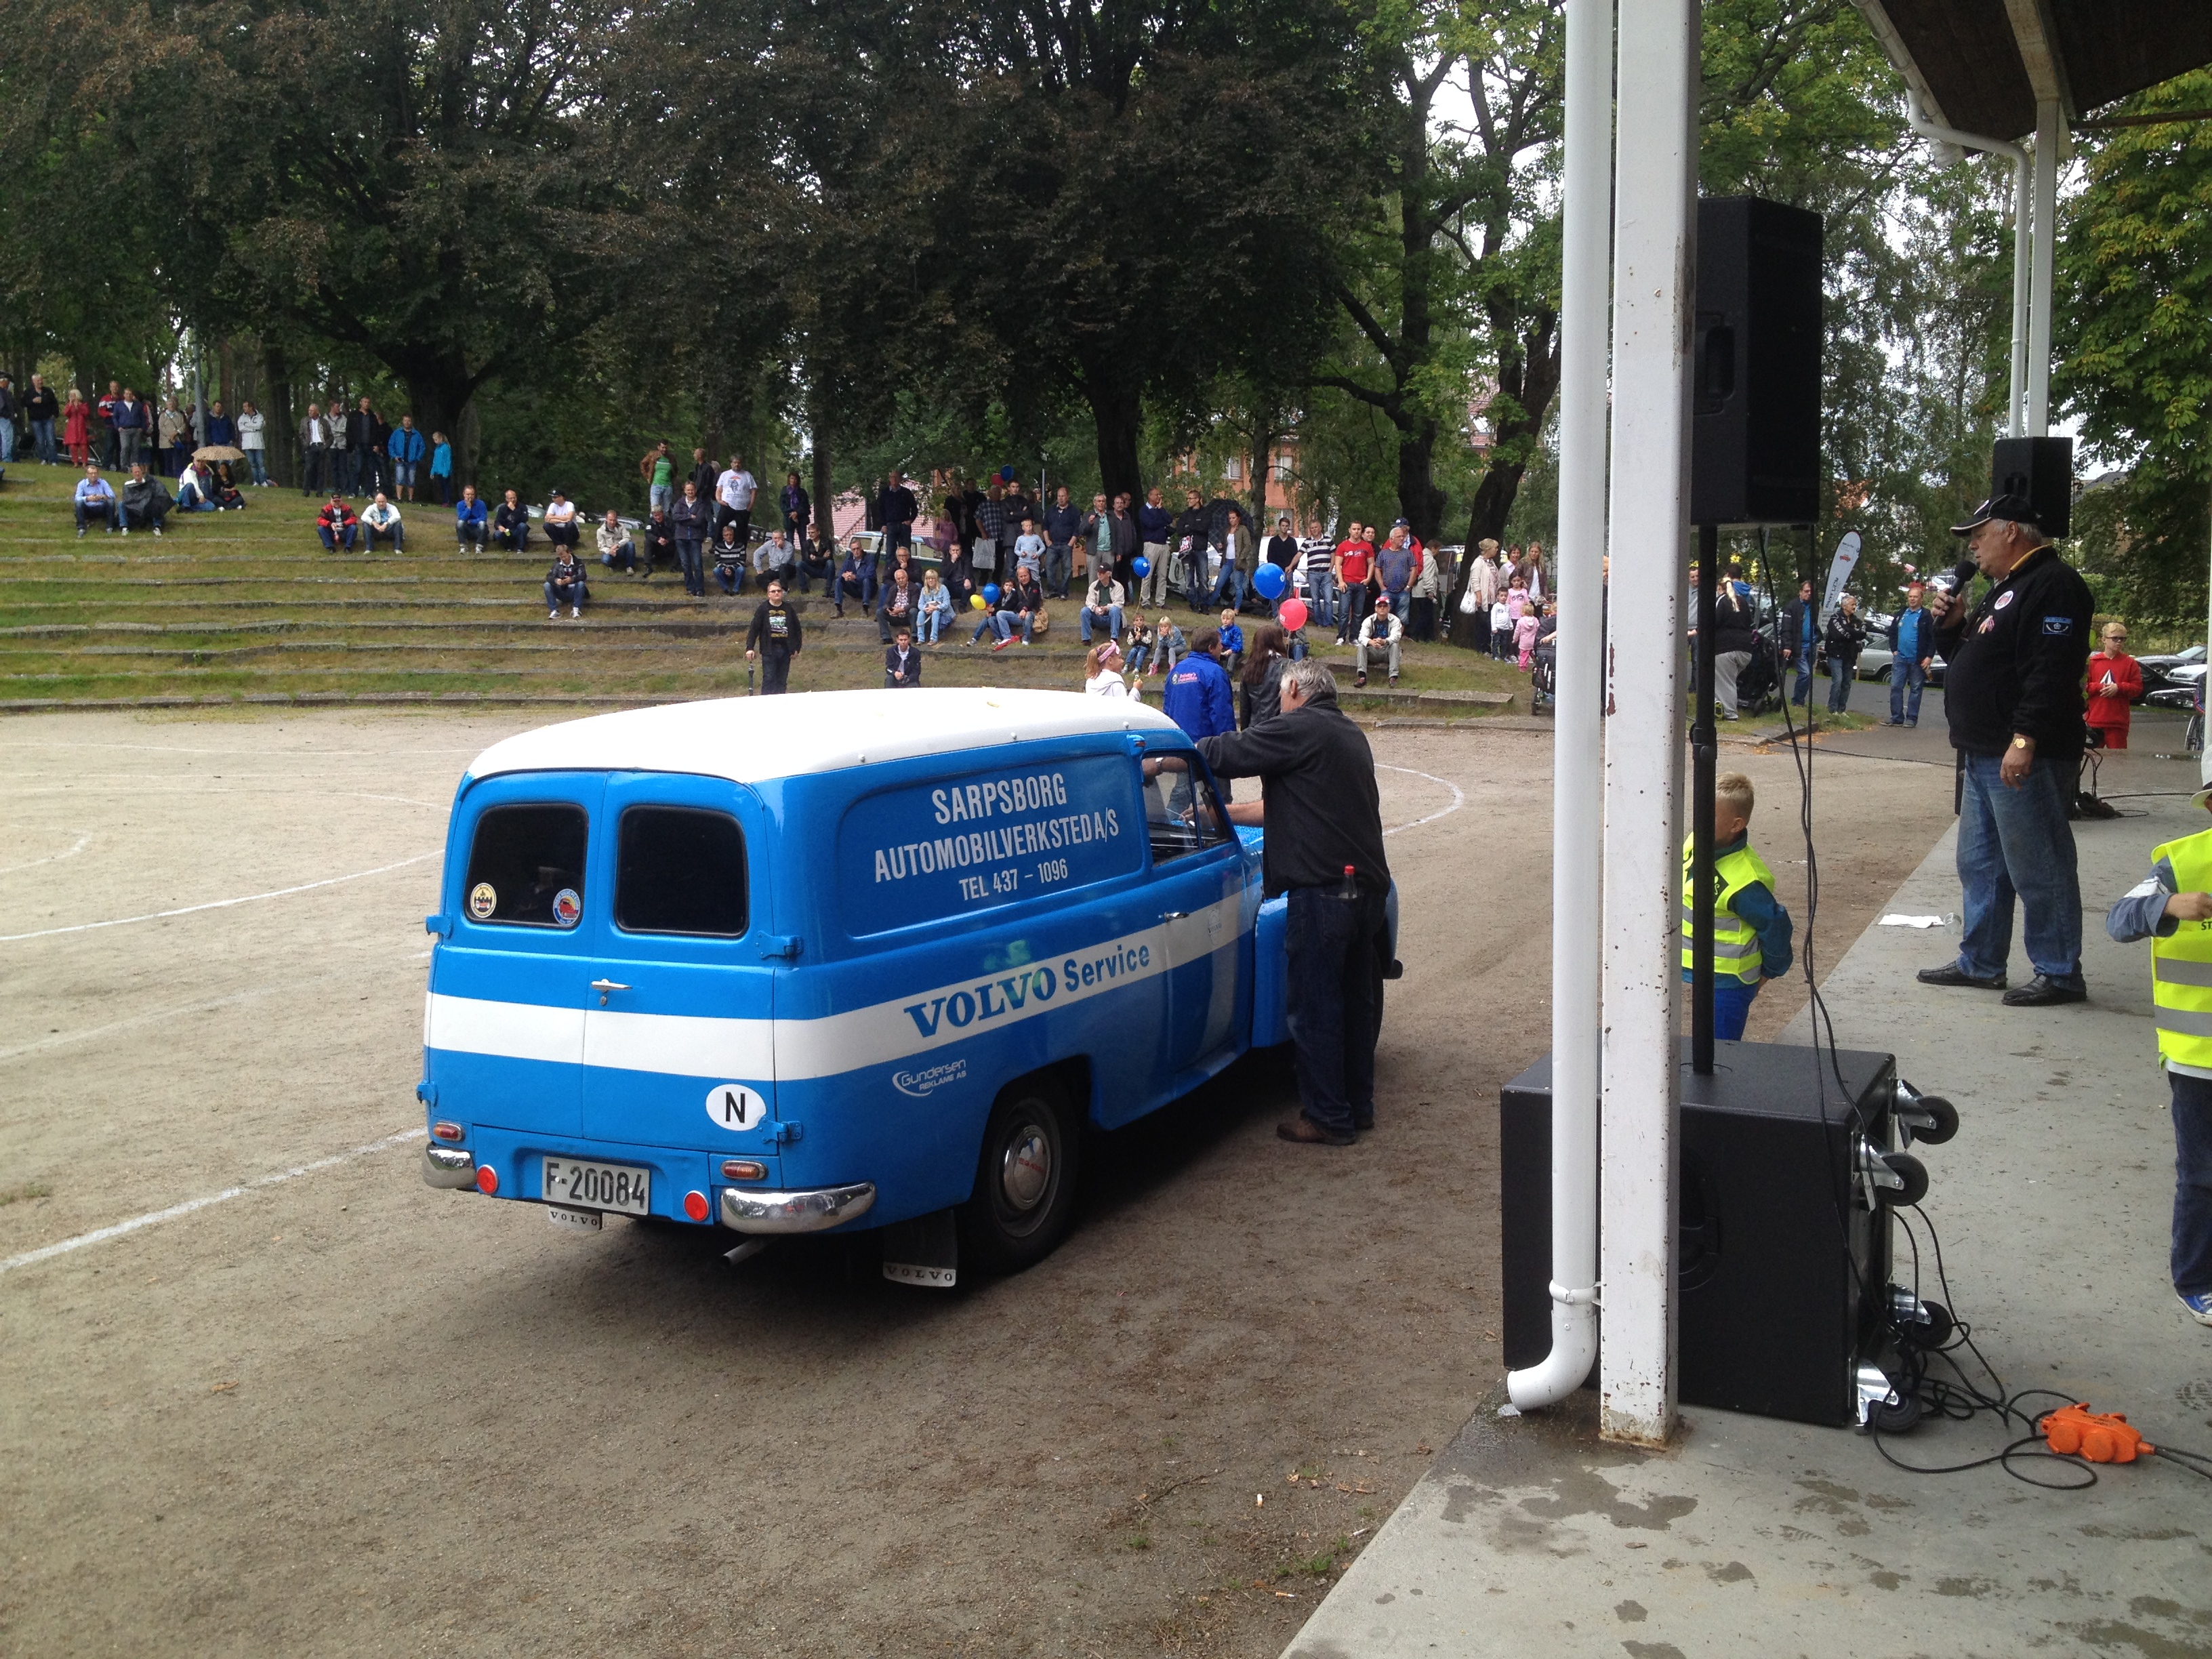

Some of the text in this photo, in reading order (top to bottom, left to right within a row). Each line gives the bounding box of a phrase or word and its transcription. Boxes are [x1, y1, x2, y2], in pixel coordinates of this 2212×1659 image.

[932, 773, 1067, 824] SARPSBORG
[959, 876, 989, 901] TEL
[993, 869, 1018, 893] 437
[1038, 859, 1068, 884] 1096
[904, 944, 1150, 1038] VOLVO Service
[901, 1059, 966, 1086] Gundersen
[919, 1073, 955, 1091] REKLAME
[725, 1091, 746, 1124] N
[546, 1162, 644, 1209] F-20084
[550, 1210, 598, 1226] VOLVO
[886, 1265, 953, 1282] VOLVO
